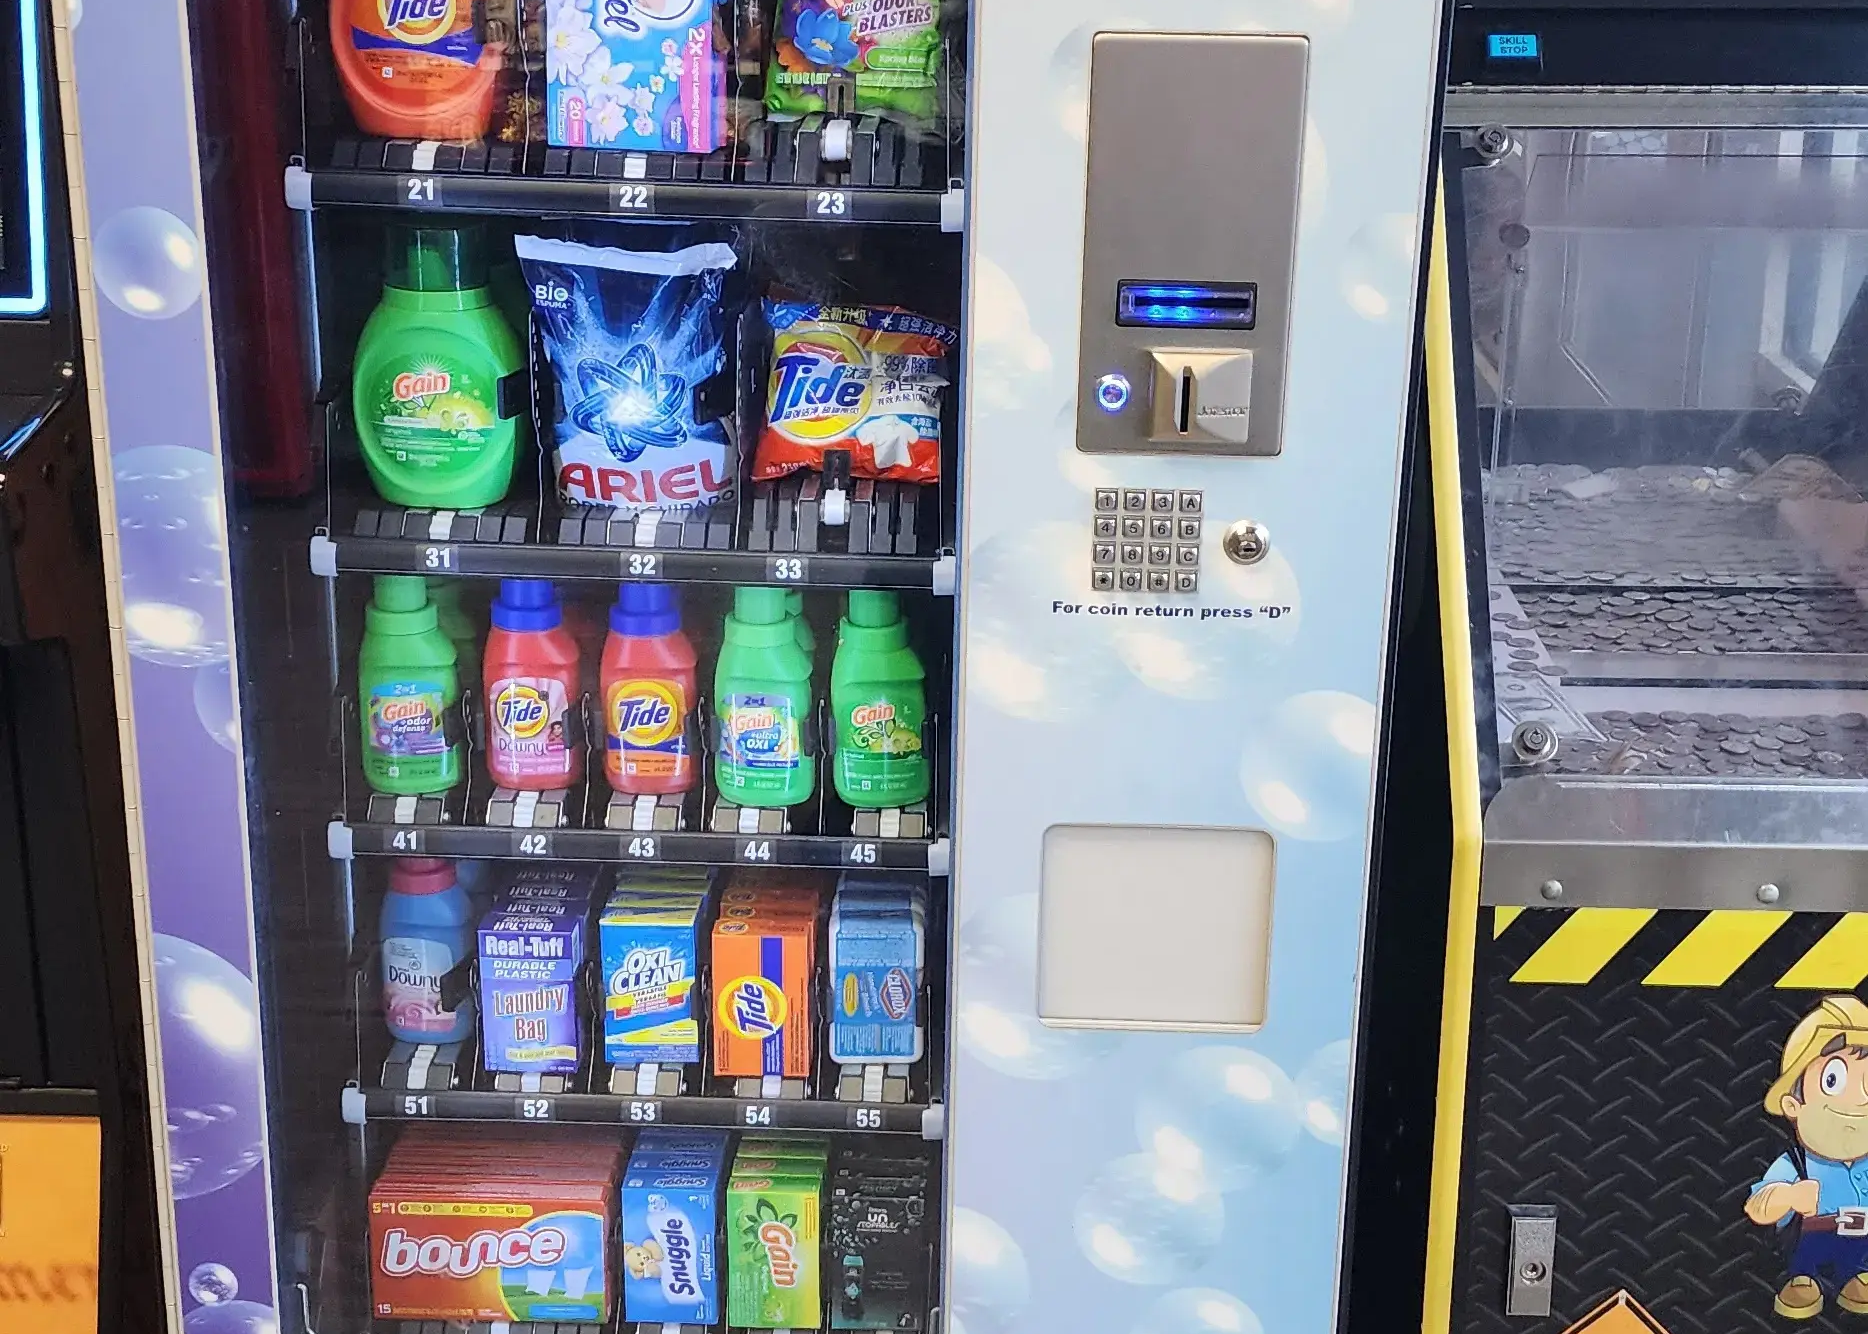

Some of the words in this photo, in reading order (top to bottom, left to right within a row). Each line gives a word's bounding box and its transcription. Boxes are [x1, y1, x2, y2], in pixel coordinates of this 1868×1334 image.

[844, 1, 868, 16] PLUS
[858, 6, 932, 33] BLASTERS
[1498, 36, 1529, 45] SKILL
[1500, 46, 1529, 54] STOP
[569, 100, 582, 121] 20
[408, 178, 433, 200] 21
[619, 186, 647, 208] 22
[817, 191, 844, 214] 23
[395, 372, 449, 399] Gain
[770, 353, 866, 424] Tide
[559, 458, 733, 503] ARIEL
[1104, 497, 1110, 507] 1
[1131, 497, 1139, 507] 2
[1158, 497, 1167, 508] 3
[1186, 498, 1195, 509] A
[1101, 523, 1109, 533] 4
[1129, 523, 1138, 533] 5
[1157, 524, 1166, 535] 6
[1185, 525, 1194, 535] B
[426, 548, 451, 568] 31
[630, 554, 655, 574] 32
[1101, 549, 1109, 560] 7
[1128, 549, 1137, 560] 8
[1156, 550, 1164, 561] 9
[1183, 551, 1193, 562] C
[776, 559, 801, 579] 33
[1126, 576, 1135, 587] 0
[1181, 577, 1191, 588] D
[1052, 600, 1083, 615] For
[1088, 602, 1128, 617] coin
[1134, 604, 1194, 618] return
[1199, 606, 1255, 621] press
[384, 700, 426, 721] Gain
[502, 700, 542, 727] Tide
[618, 698, 671, 733] Tide
[853, 704, 894, 724] Gain
[392, 724, 426, 734] defense
[736, 714, 774, 731] Gain
[499, 737, 546, 756] Downy
[393, 831, 416, 849] 41
[520, 835, 546, 854] 42
[628, 838, 654, 857] 43
[744, 841, 770, 860] 44
[851, 844, 875, 863] 45
[485, 935, 564, 957] Real-Tuff
[493, 960, 557, 971] DURABLE
[627, 949, 667, 975] OXI
[389, 964, 441, 993] Downy
[494, 969, 551, 979] PLASTIC
[613, 961, 682, 996] CLEAN
[494, 984, 568, 1017] Laundry
[886, 974, 907, 1015] CLOROX
[739, 982, 775, 1033] Tide
[515, 1017, 547, 1042] Bag
[405, 1096, 427, 1114] 51
[523, 1100, 548, 1117] 52
[630, 1102, 655, 1120] 53
[746, 1106, 770, 1124] 54
[857, 1109, 880, 1127] 55
[382, 1228, 565, 1276] bounce
[660, 1218, 696, 1296] Snuggle
[761, 1225, 798, 1286] Gain
[377, 1304, 392, 1315] 15
